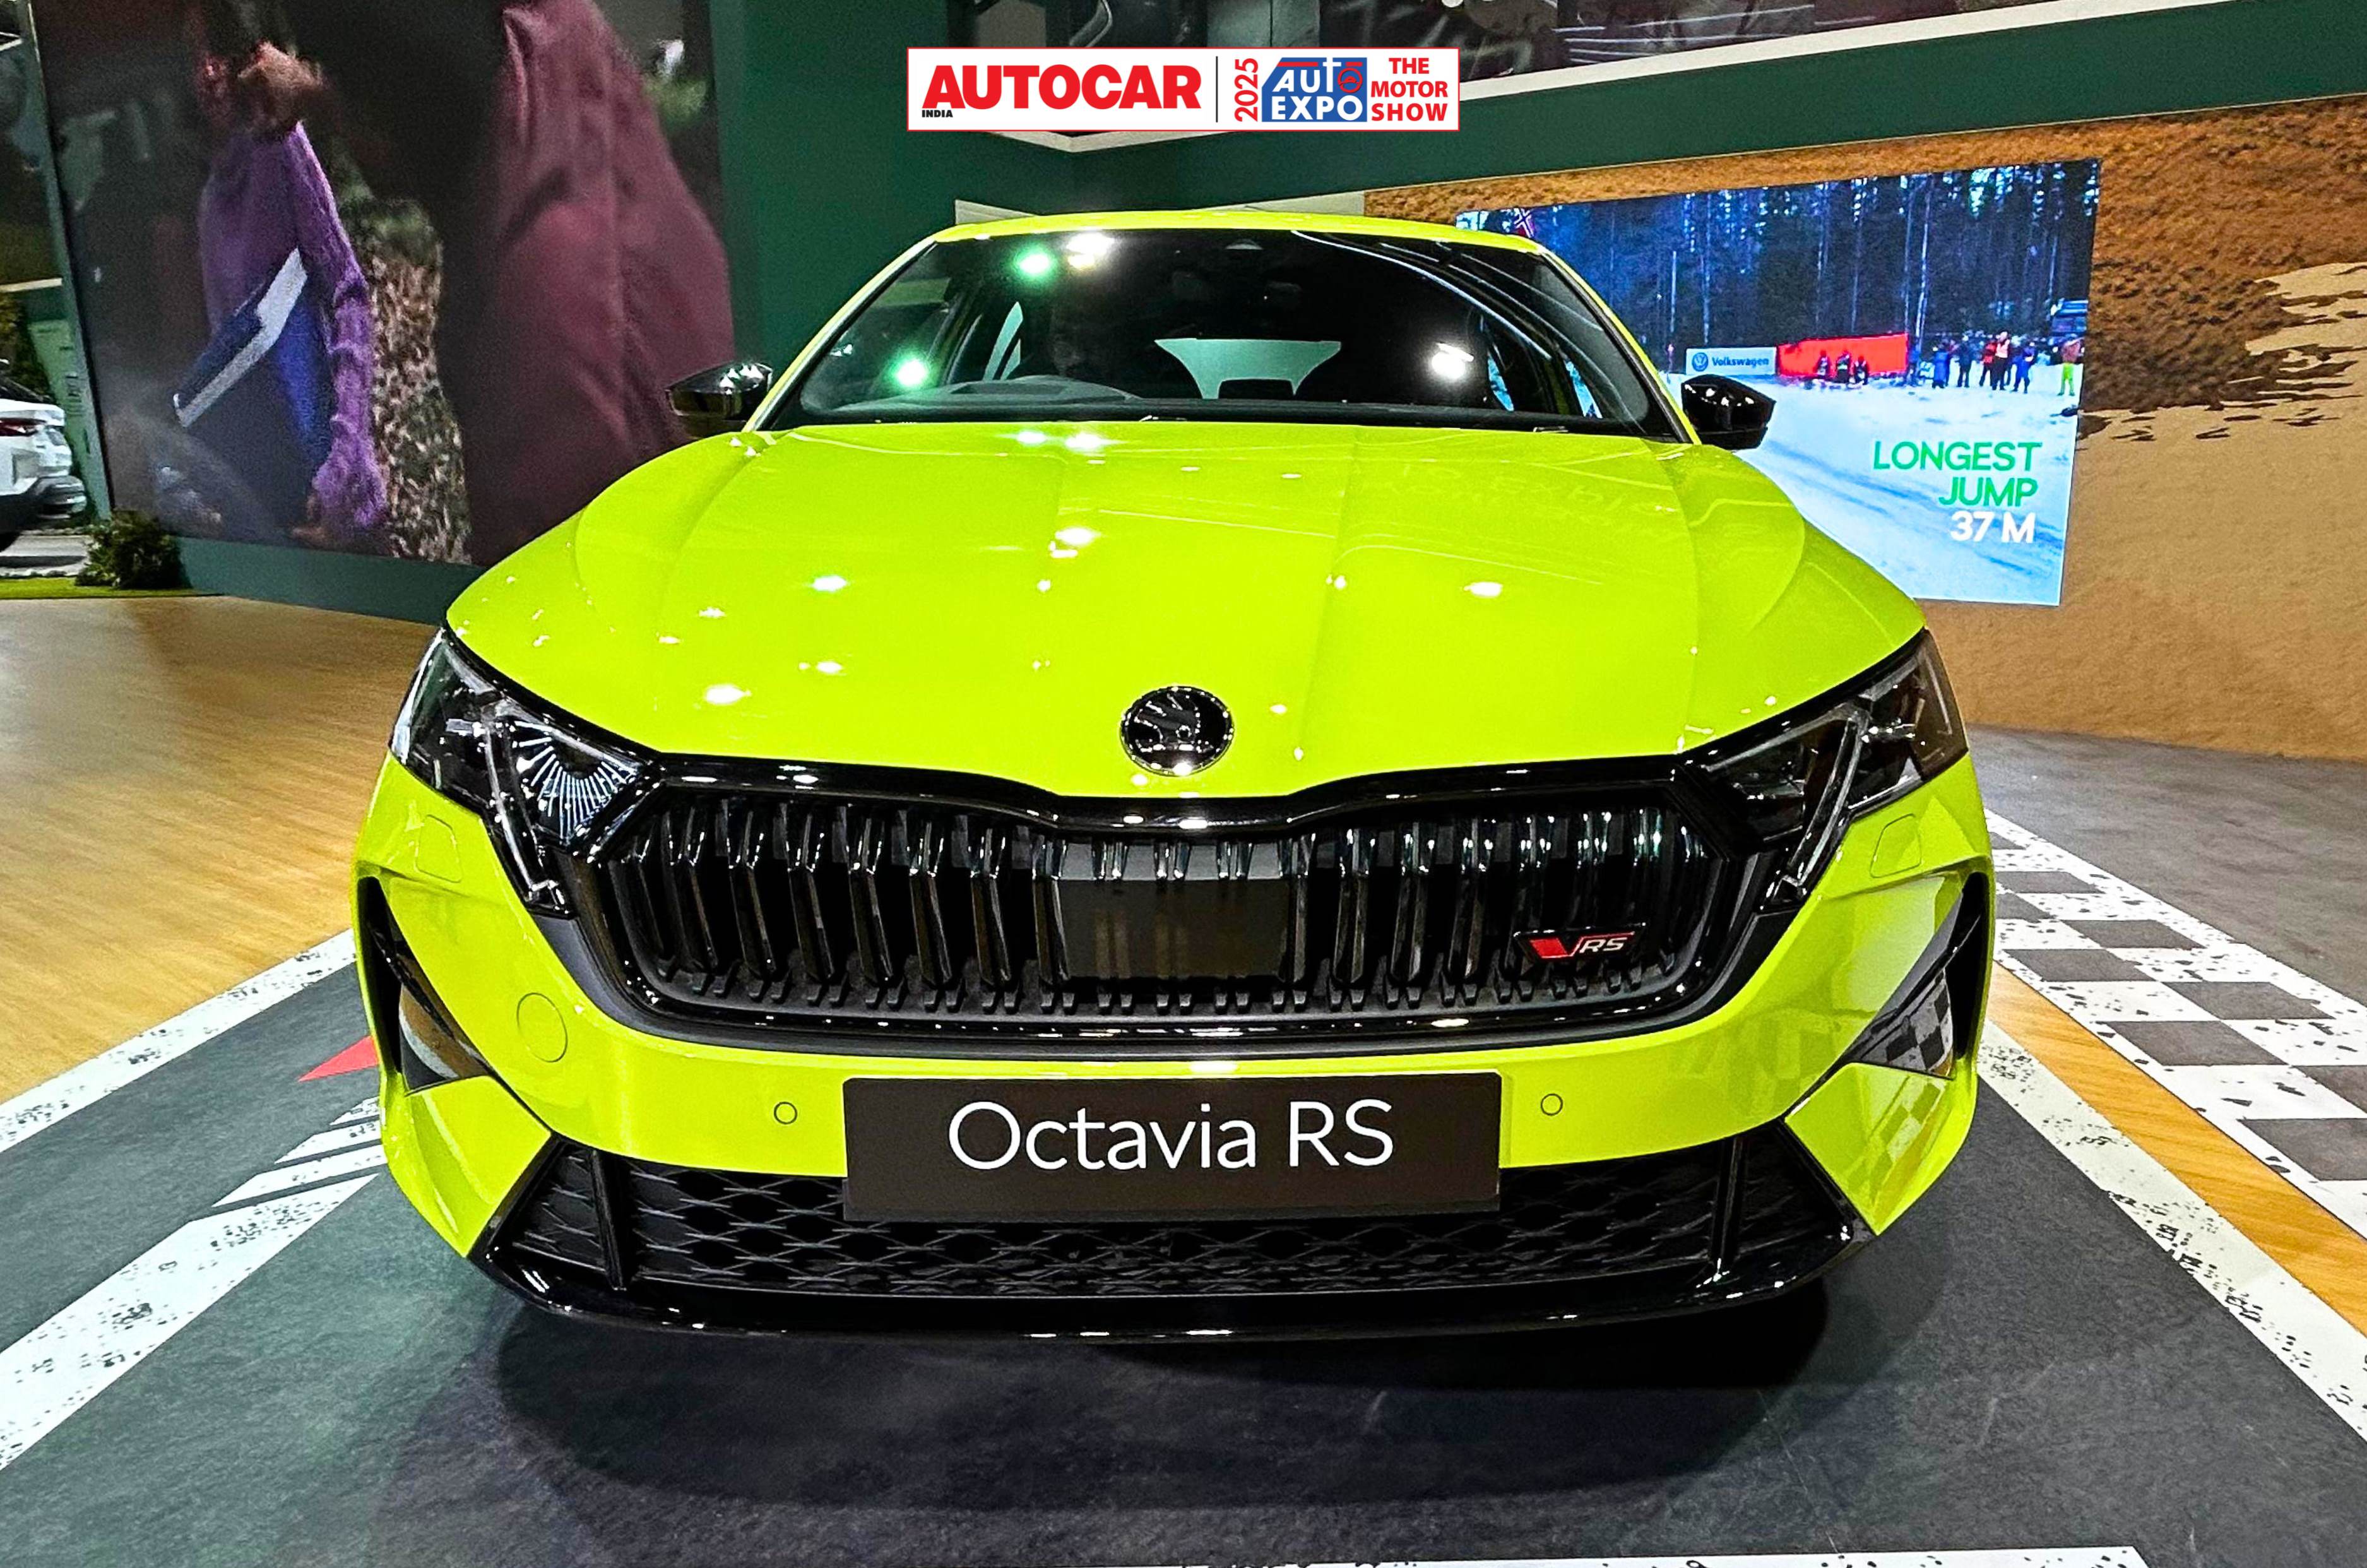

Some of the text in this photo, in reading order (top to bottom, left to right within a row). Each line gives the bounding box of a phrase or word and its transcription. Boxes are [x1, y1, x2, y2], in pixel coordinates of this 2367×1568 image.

[1712, 356, 1769, 368] Volkswagen
[1873, 441, 2043, 472] LONGEST
[1938, 477, 2039, 508] JUMP
[1950, 510, 2036, 543] 37 M
[949, 1099, 1393, 1170] Octavia RS
